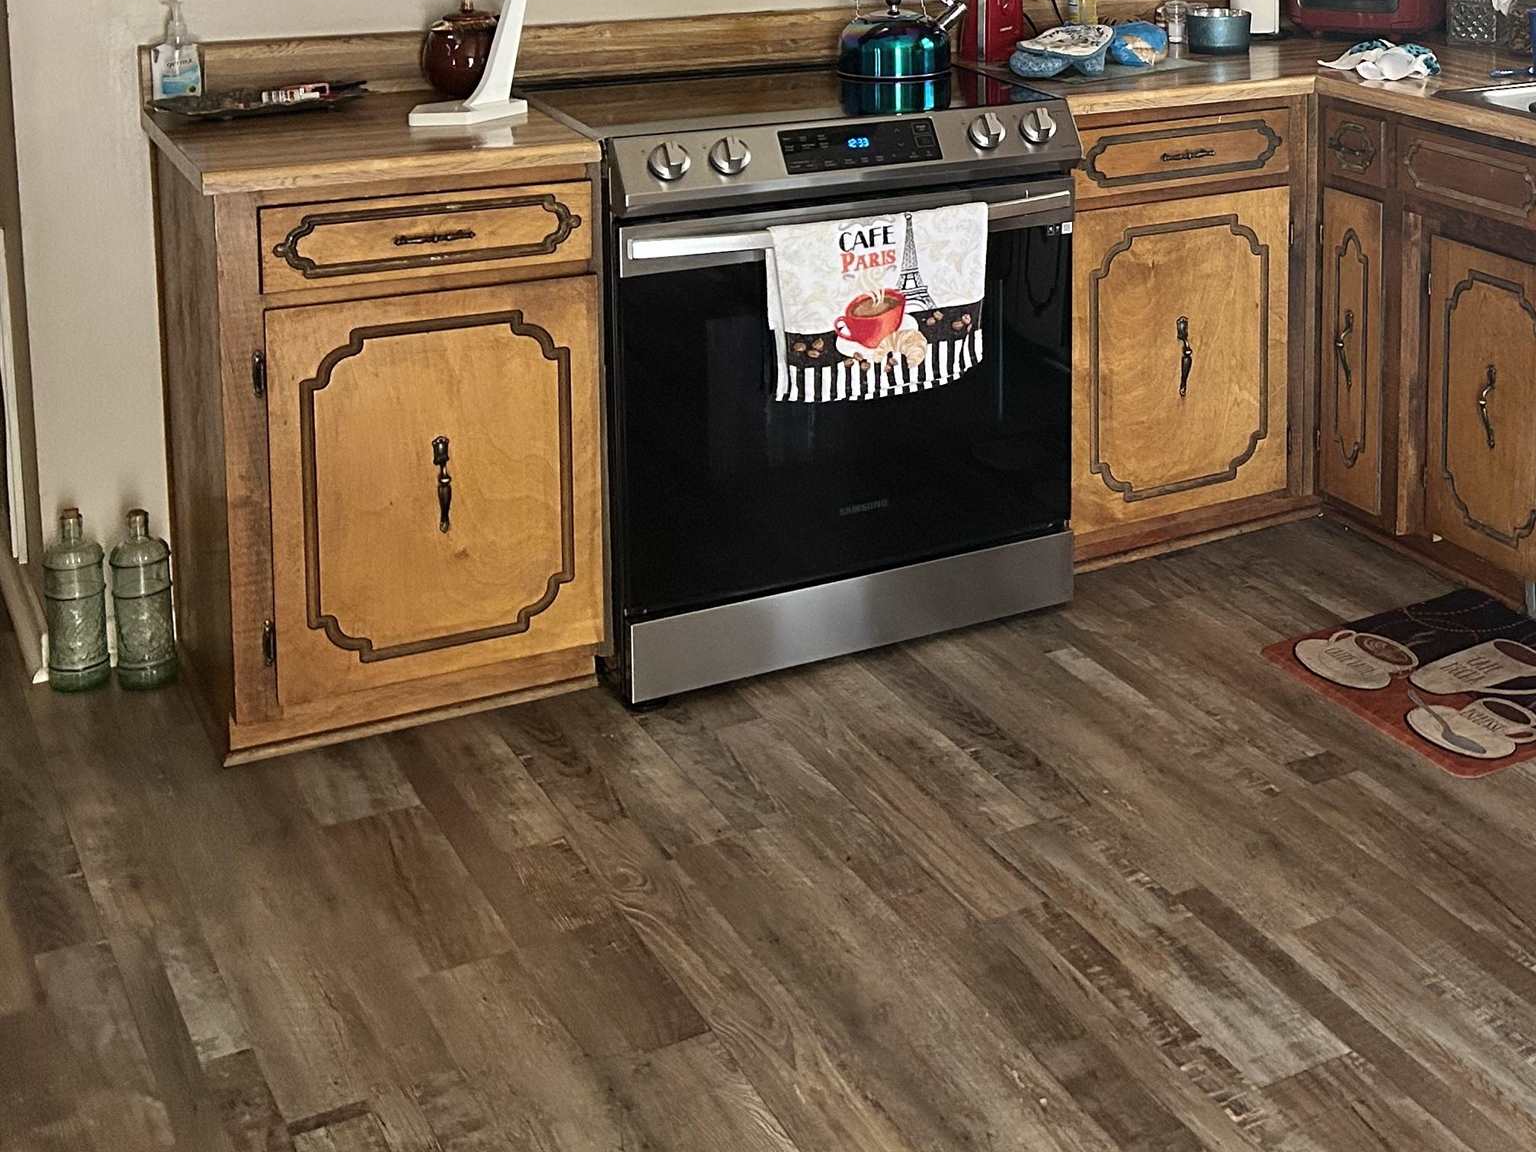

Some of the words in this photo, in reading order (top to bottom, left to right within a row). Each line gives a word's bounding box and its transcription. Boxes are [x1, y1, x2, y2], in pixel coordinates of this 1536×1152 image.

[847, 137, 870, 149] 12:33
[838, 224, 897, 252] CAFE
[840, 249, 897, 274] PARIS
